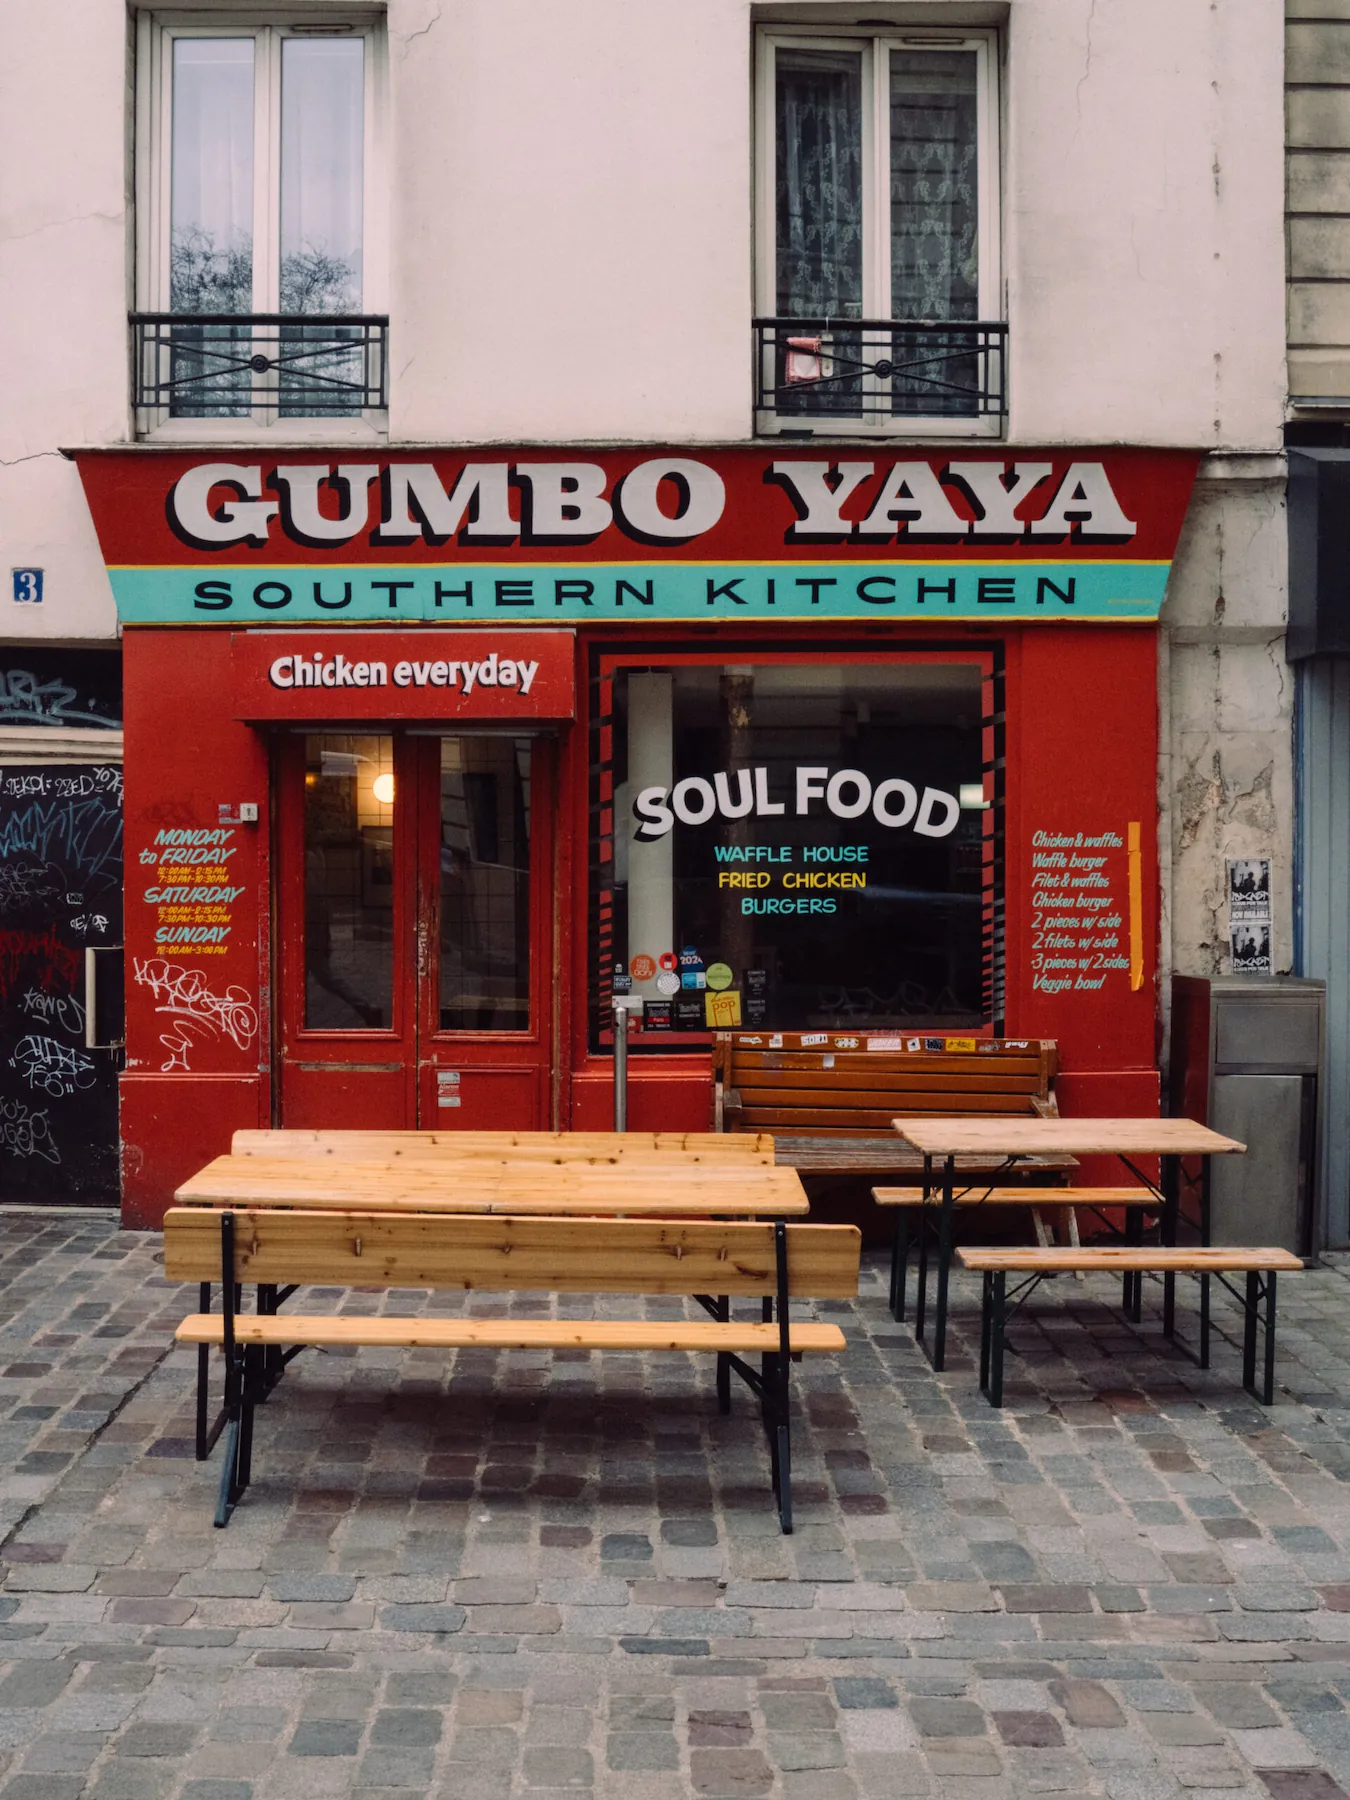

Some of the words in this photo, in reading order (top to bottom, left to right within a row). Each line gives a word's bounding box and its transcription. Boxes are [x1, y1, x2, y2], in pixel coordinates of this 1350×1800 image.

[169, 458, 726, 547] GUMBO
[767, 460, 1137, 541] YAYA
[19, 572, 38, 602] 3
[193, 579, 654, 610] SOUTHERN
[706, 576, 1076, 605] KITCHEN
[268, 652, 388, 690] Chicken
[393, 652, 540, 695] everyday
[635, 767, 786, 838] SOUL
[796, 766, 961, 839] FOOD
[153, 829, 236, 845] MONDAY
[1031, 830, 1074, 848] Chicken
[1074, 832, 1083, 848] &
[1084, 832, 1123, 848] waffles
[139, 848, 158, 864] to
[159, 848, 237, 865] FRIDAY
[714, 846, 792, 863] WAFFLE
[803, 846, 870, 863] HOUSE
[1032, 852, 1067, 868] Waffle
[1069, 852, 1108, 871] burger
[718, 872, 772, 889] FRIED
[782, 872, 867, 889] CHICKEN
[1031, 873, 1060, 888] Filet
[1060, 873, 1070, 888] &
[1071, 873, 1110, 888] waffles
[143, 887, 246, 904] SATURDAY
[1032, 891, 1074, 908] Chicken
[1076, 892, 1114, 912] burger
[741, 898, 837, 916] BURGERS
[1031, 912, 1043, 929] 2
[1043, 912, 1080, 931] pieces
[1081, 915, 1098, 931] w/
[1097, 912, 1122, 929] side
[153, 926, 232, 943] SUNDAY
[1032, 932, 1044, 949] 2
[1044, 932, 1075, 949] filets
[1078, 936, 1094, 951] w/
[1093, 932, 1118, 948] side
[1031, 953, 1044, 970] 3
[1043, 954, 1077, 973] pieces
[1078, 955, 1095, 972] w/
[1093, 953, 1105, 970] 2
[1103, 954, 1130, 970] sides
[1032, 973, 1072, 994] Veggie
[1074, 973, 1107, 990] bowl
